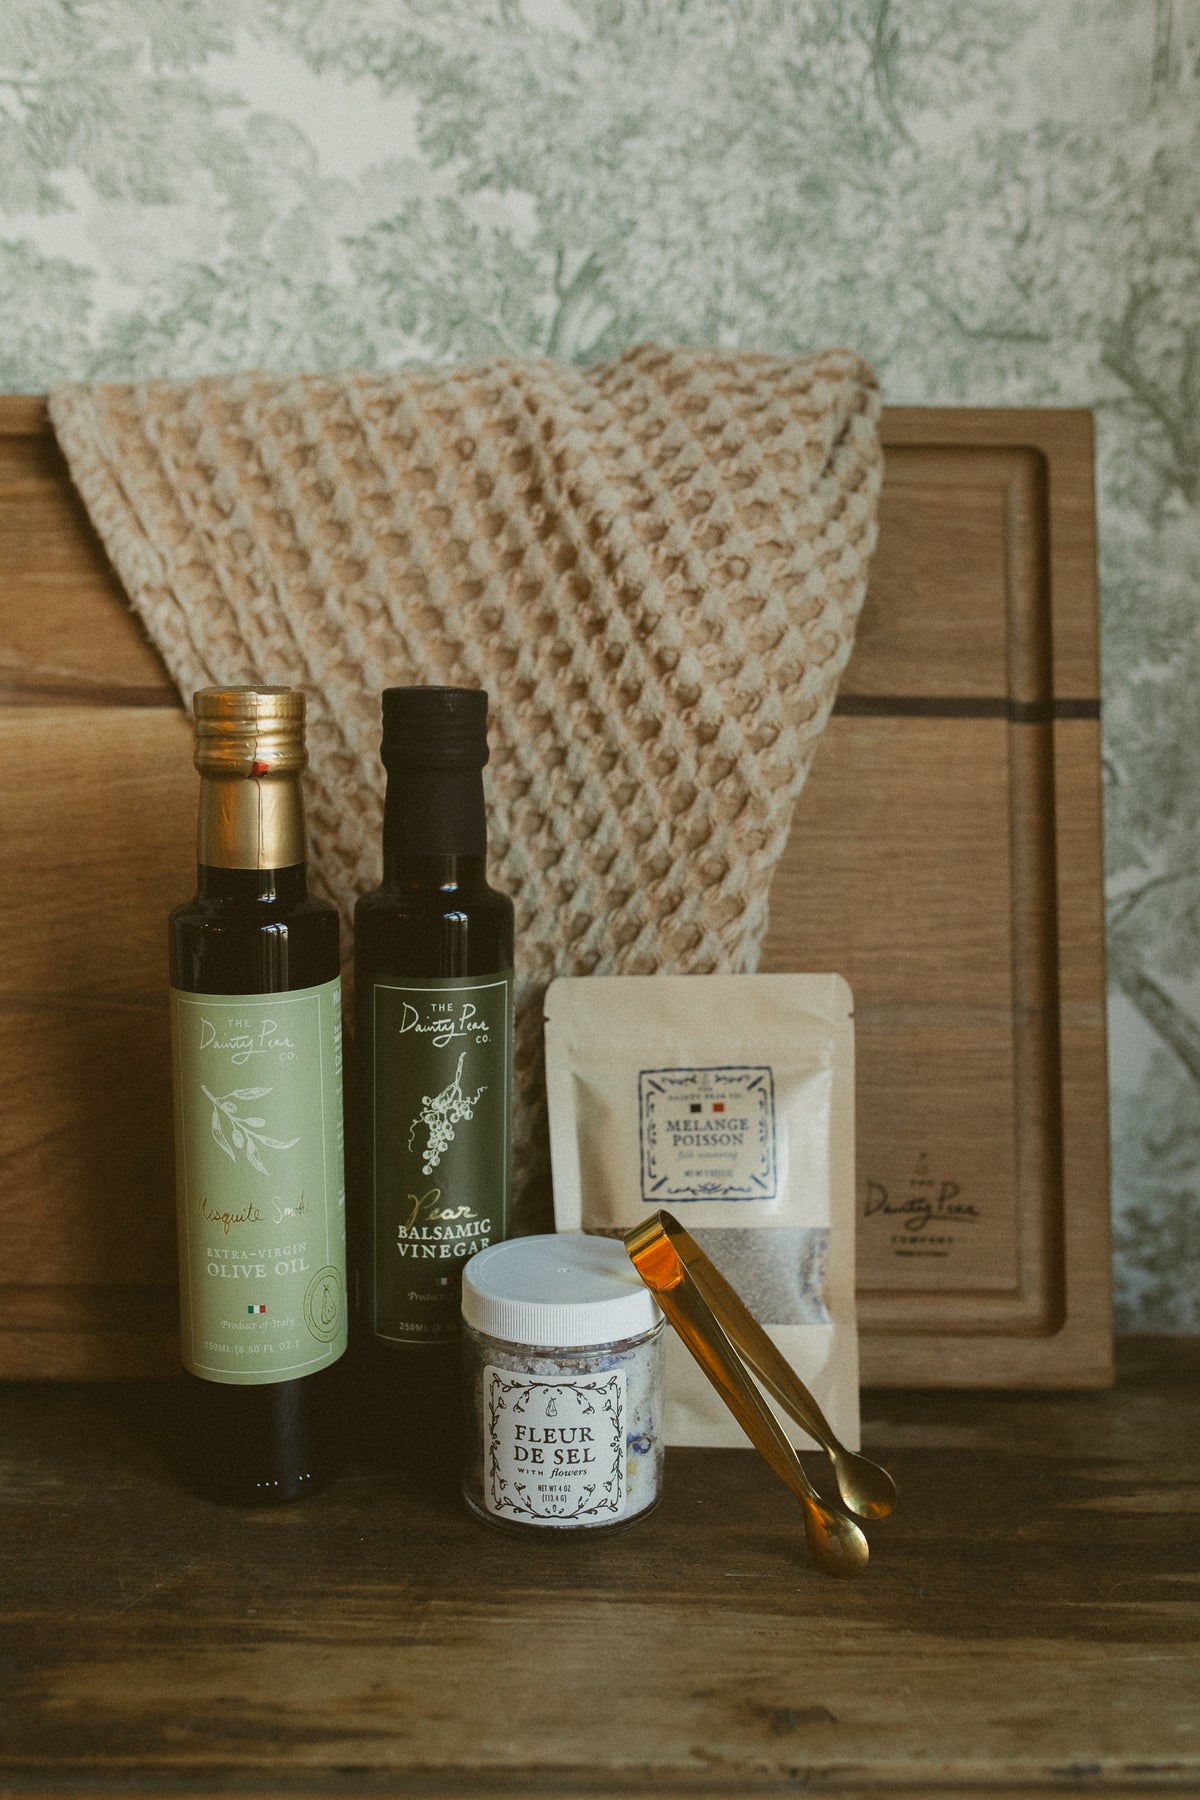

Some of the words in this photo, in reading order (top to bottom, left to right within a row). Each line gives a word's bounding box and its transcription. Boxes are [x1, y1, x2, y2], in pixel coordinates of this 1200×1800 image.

[431, 1003, 453, 1011] THE
[228, 1019, 251, 1028] THE
[399, 1001, 467, 1048] Dainty
[459, 1003, 489, 1031] Pear
[200, 1017, 267, 1065] Dainty
[259, 1019, 295, 1048] Pear
[475, 1034, 492, 1044] CO.
[279, 1052, 299, 1061] CO.
[666, 1117, 749, 1132] MELANGE
[673, 1133, 744, 1147] POISSON
[405, 1188, 478, 1231] Pear
[397, 1218, 491, 1240] BALSAMIC
[206, 1242, 307, 1260] EXTRA-VIRGIN
[397, 1237, 490, 1259] VINEGAR
[206, 1262, 267, 1279] OLIVE
[274, 1257, 310, 1276] OIL
[221, 1320, 256, 1330] Product
[259, 1319, 269, 1333] of
[271, 1317, 295, 1330] Italy
[204, 1341, 231, 1353] 250ML
[264, 1344, 275, 1353] FL
[514, 1424, 594, 1444] FLEUR
[514, 1445, 544, 1464] DE
[553, 1447, 596, 1465] SEL
[517, 1467, 544, 1476] WITH
[550, 1467, 587, 1479] flowers
[537, 1484, 547, 1492] NET
[549, 1484, 557, 1492] WT
